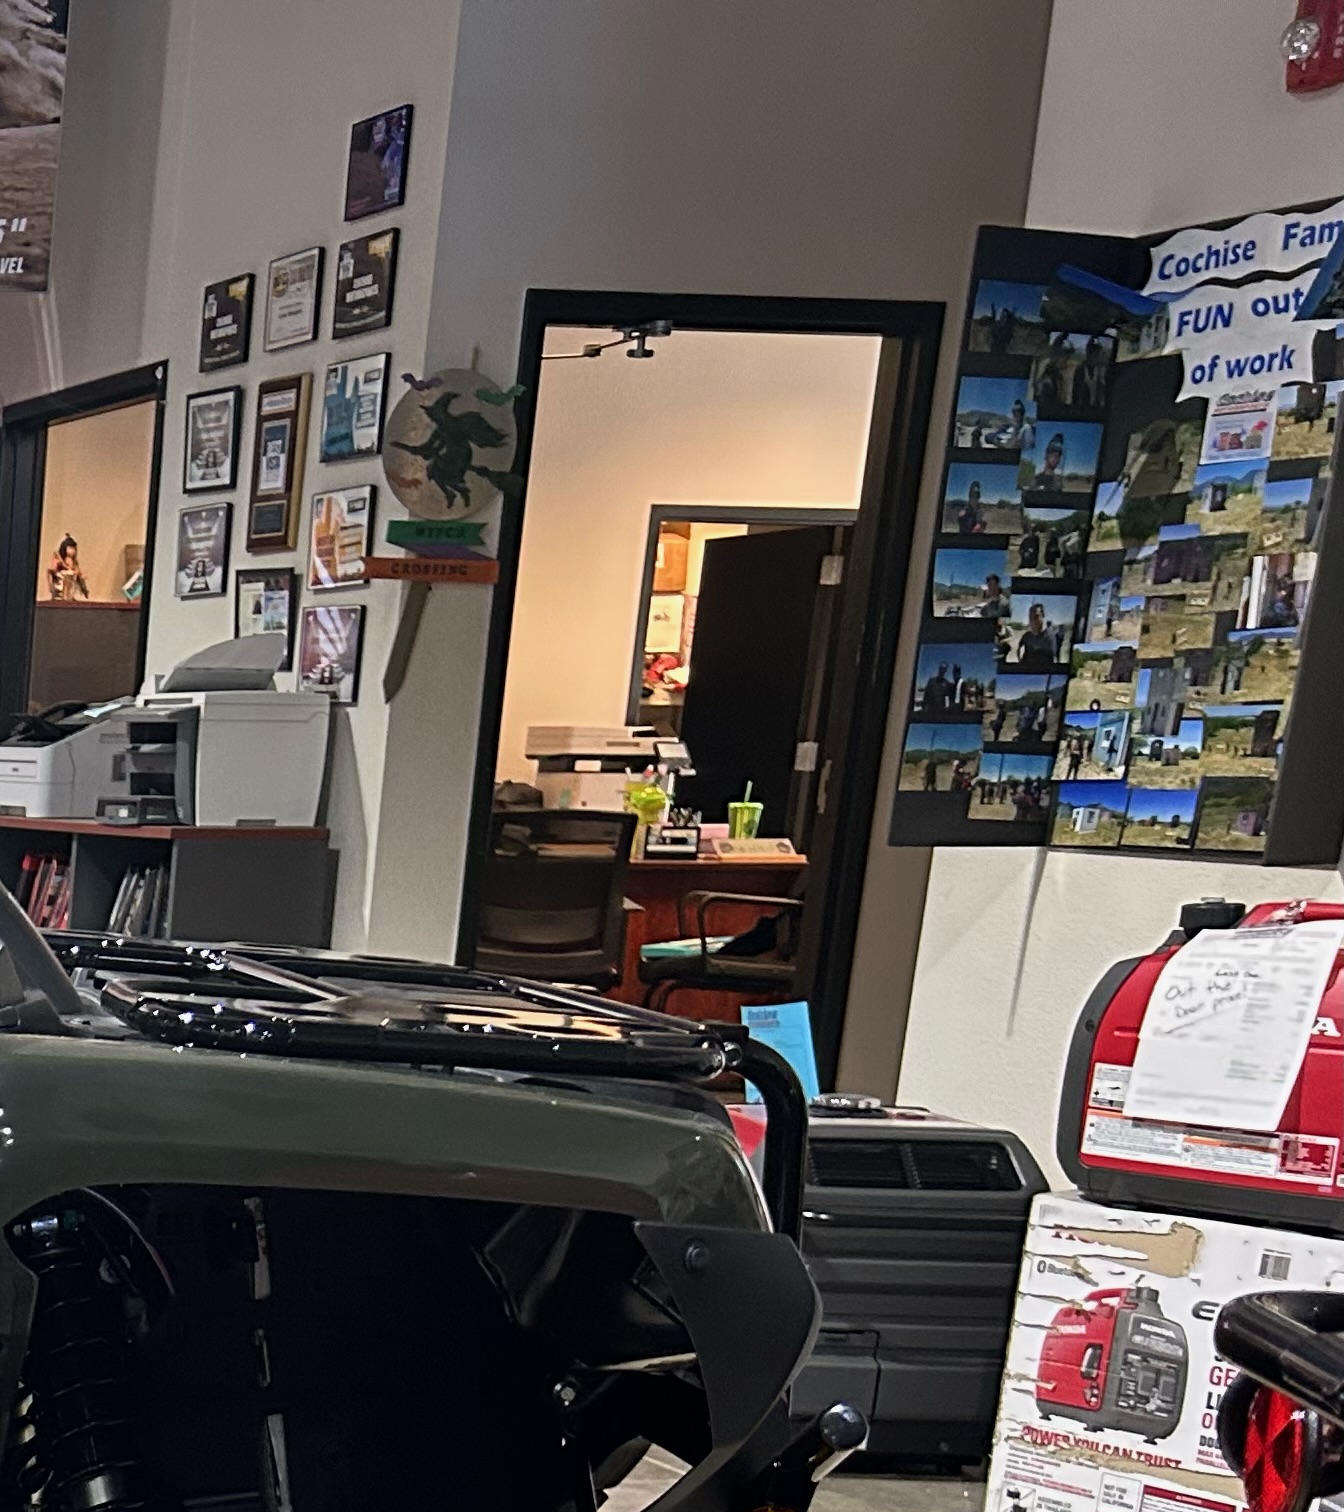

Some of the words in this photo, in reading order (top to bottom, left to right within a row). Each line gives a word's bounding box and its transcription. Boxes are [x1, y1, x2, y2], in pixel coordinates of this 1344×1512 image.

[1158, 239, 1257, 281] Cochise
[1176, 302, 1233, 338] FUN
[1251, 287, 1304, 318] out
[1190, 354, 1221, 385] of
[1226, 344, 1296, 379] work
